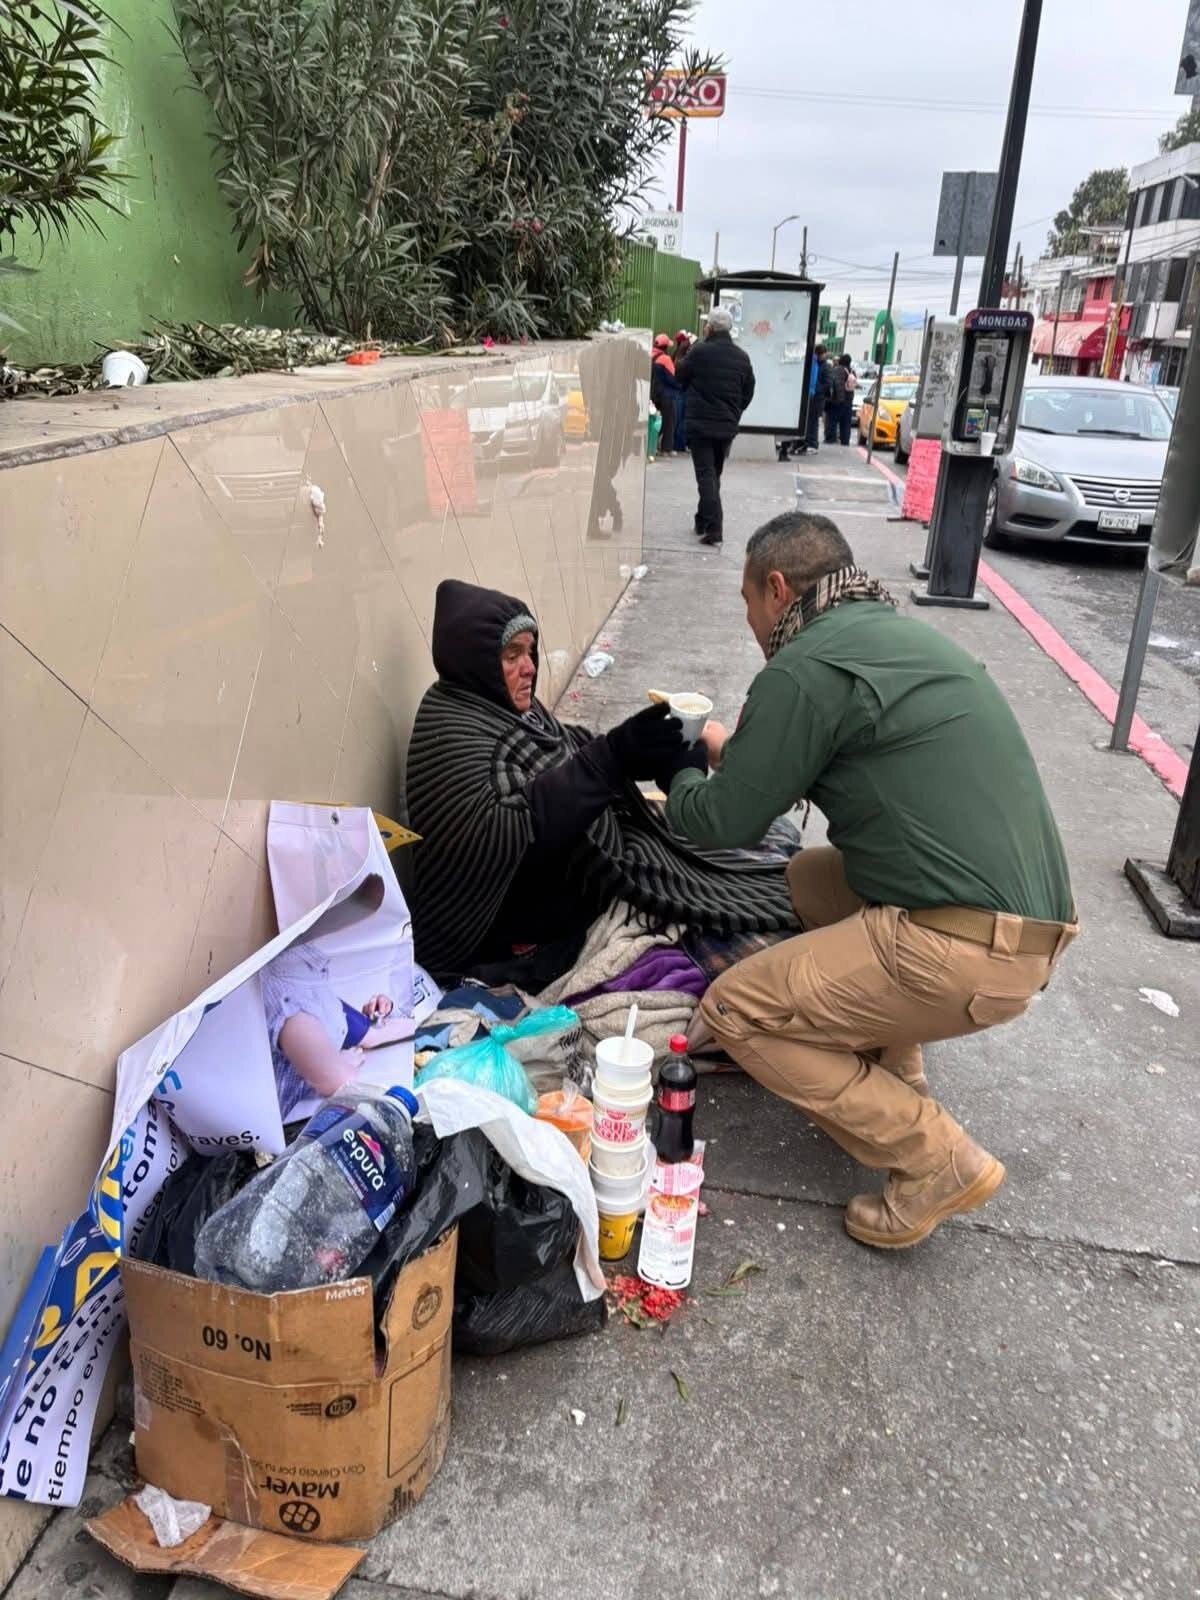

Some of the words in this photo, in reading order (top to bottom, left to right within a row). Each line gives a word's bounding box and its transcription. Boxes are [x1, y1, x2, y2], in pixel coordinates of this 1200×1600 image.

[978, 314, 1028, 328] MONEDAS
[202, 1325, 229, 1351] 60
[234, 1333, 272, 1363] No.
[25, 1384, 57, 1446] no
[48, 1388, 85, 1502] tiempo
[259, 1477, 341, 1499] Maver
